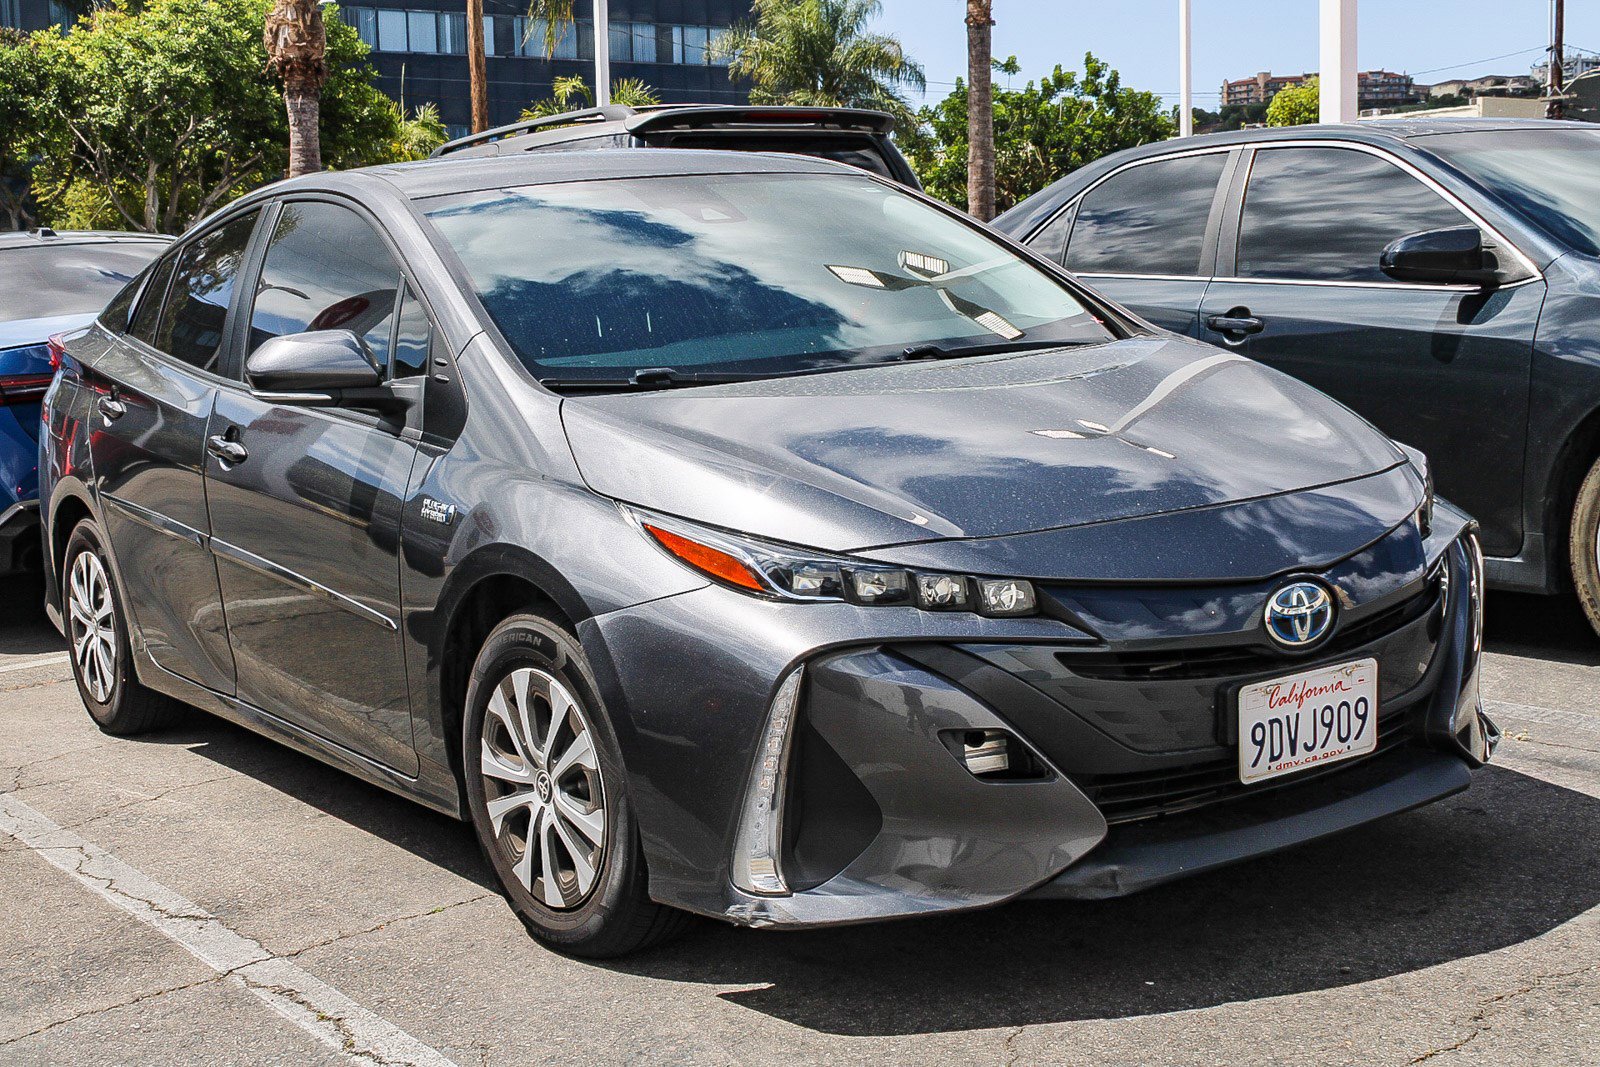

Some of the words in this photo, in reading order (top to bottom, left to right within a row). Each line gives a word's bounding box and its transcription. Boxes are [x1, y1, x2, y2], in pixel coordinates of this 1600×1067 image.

[1268, 676, 1352, 710] California
[1251, 696, 1369, 769] 9DVJ909
[1275, 748, 1344, 771] dmv.ca.gov
